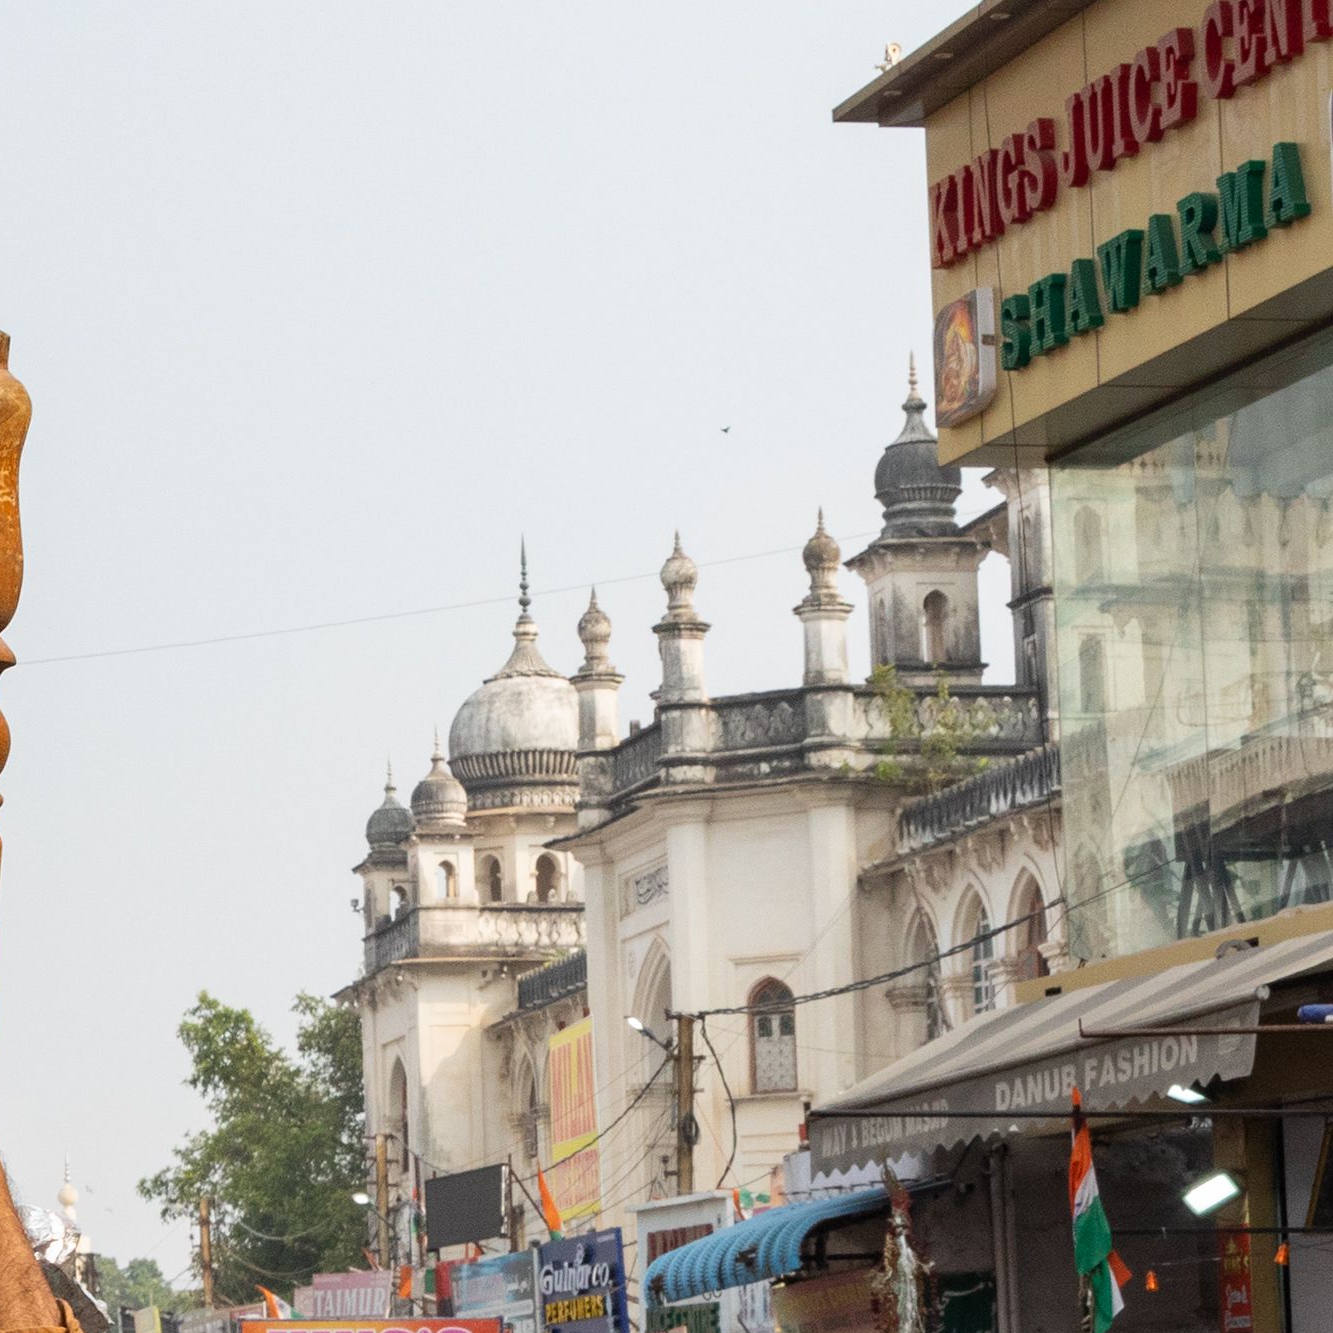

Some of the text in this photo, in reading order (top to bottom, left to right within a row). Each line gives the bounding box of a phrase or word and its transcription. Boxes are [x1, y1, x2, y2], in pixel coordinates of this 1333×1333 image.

[933, 117, 1061, 270] KINGS
[1060, 27, 1199, 188] JUICE
[1000, 142, 1312, 371] SHAWARMA
[1084, 1035, 1199, 1093] FASHION
[313, 1287, 386, 1318] TAIMUR
[545, 1295, 605, 1324] PERFUMERS
